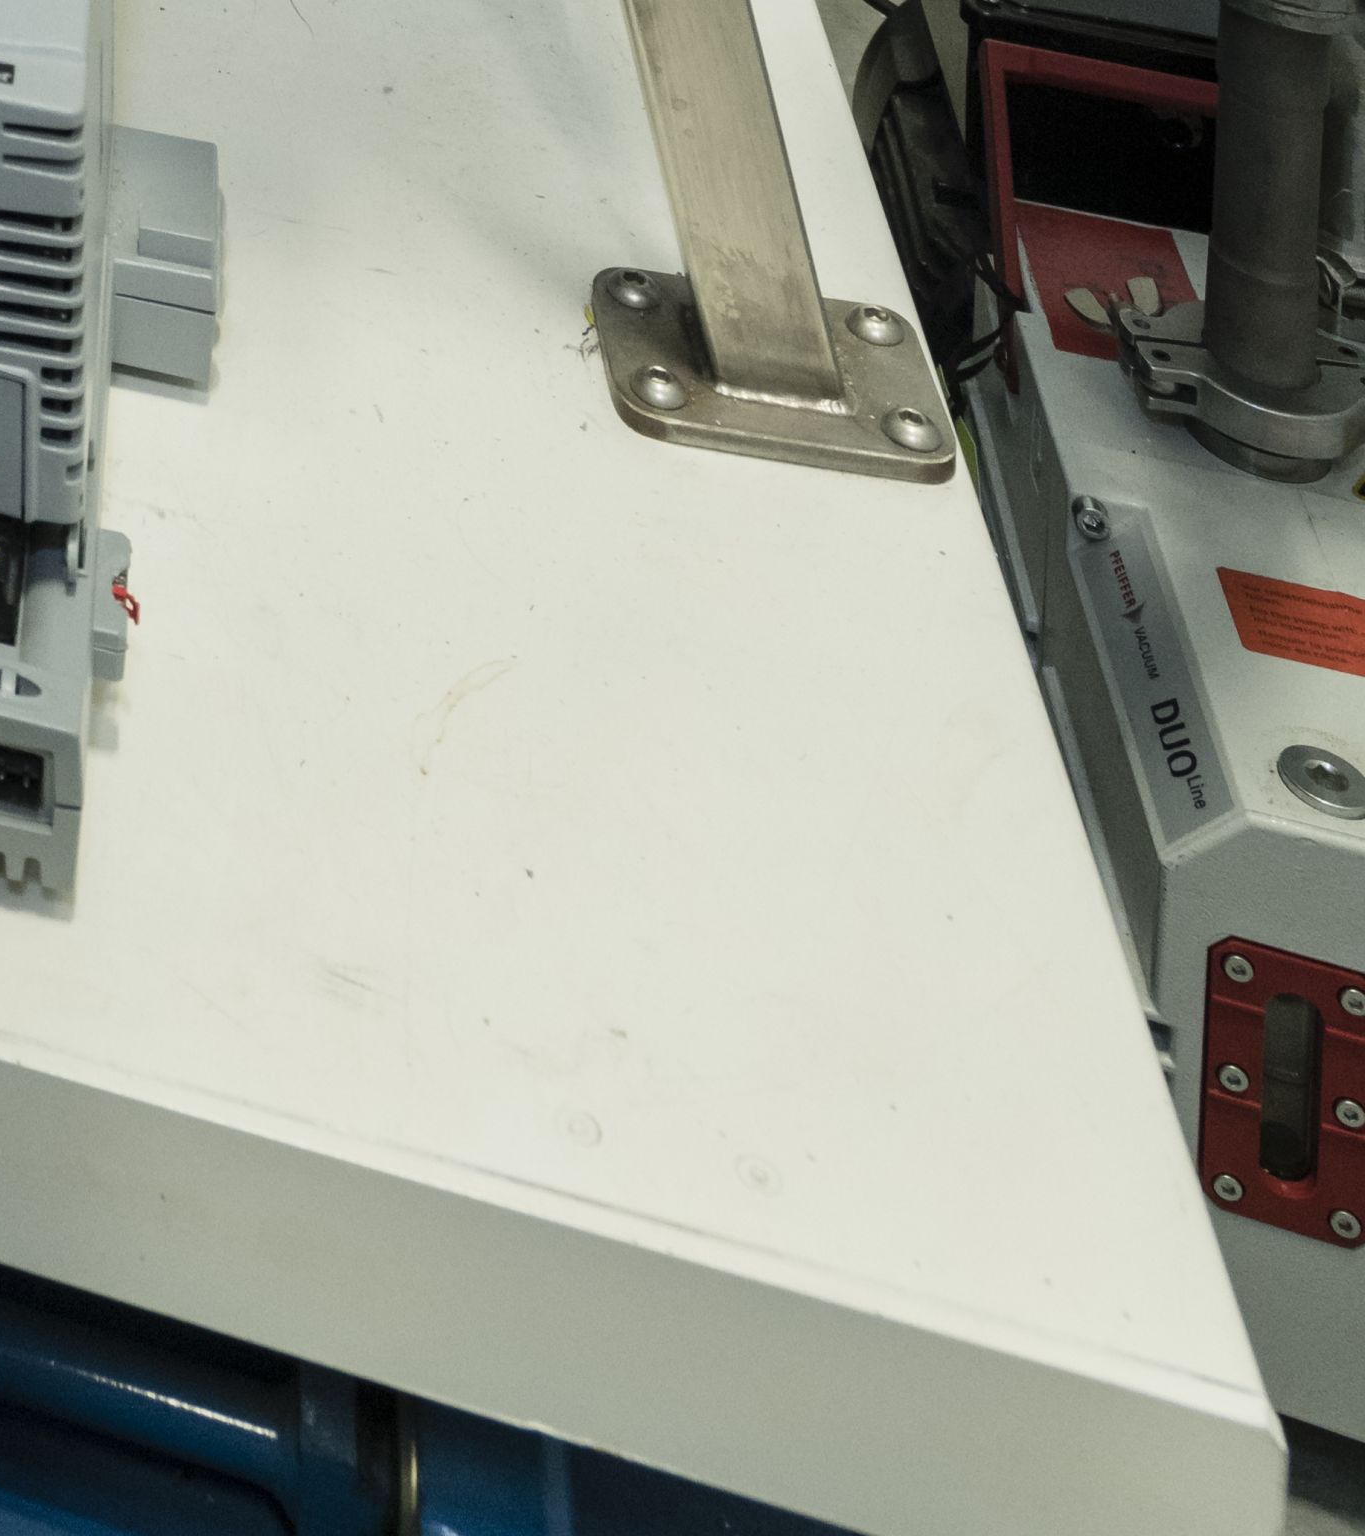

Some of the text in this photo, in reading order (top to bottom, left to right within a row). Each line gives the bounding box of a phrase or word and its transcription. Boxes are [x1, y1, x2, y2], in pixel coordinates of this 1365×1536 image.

[1109, 549, 1160, 680] PFEIFFER VACUUM
[1150, 697, 1207, 810] DUO Line
